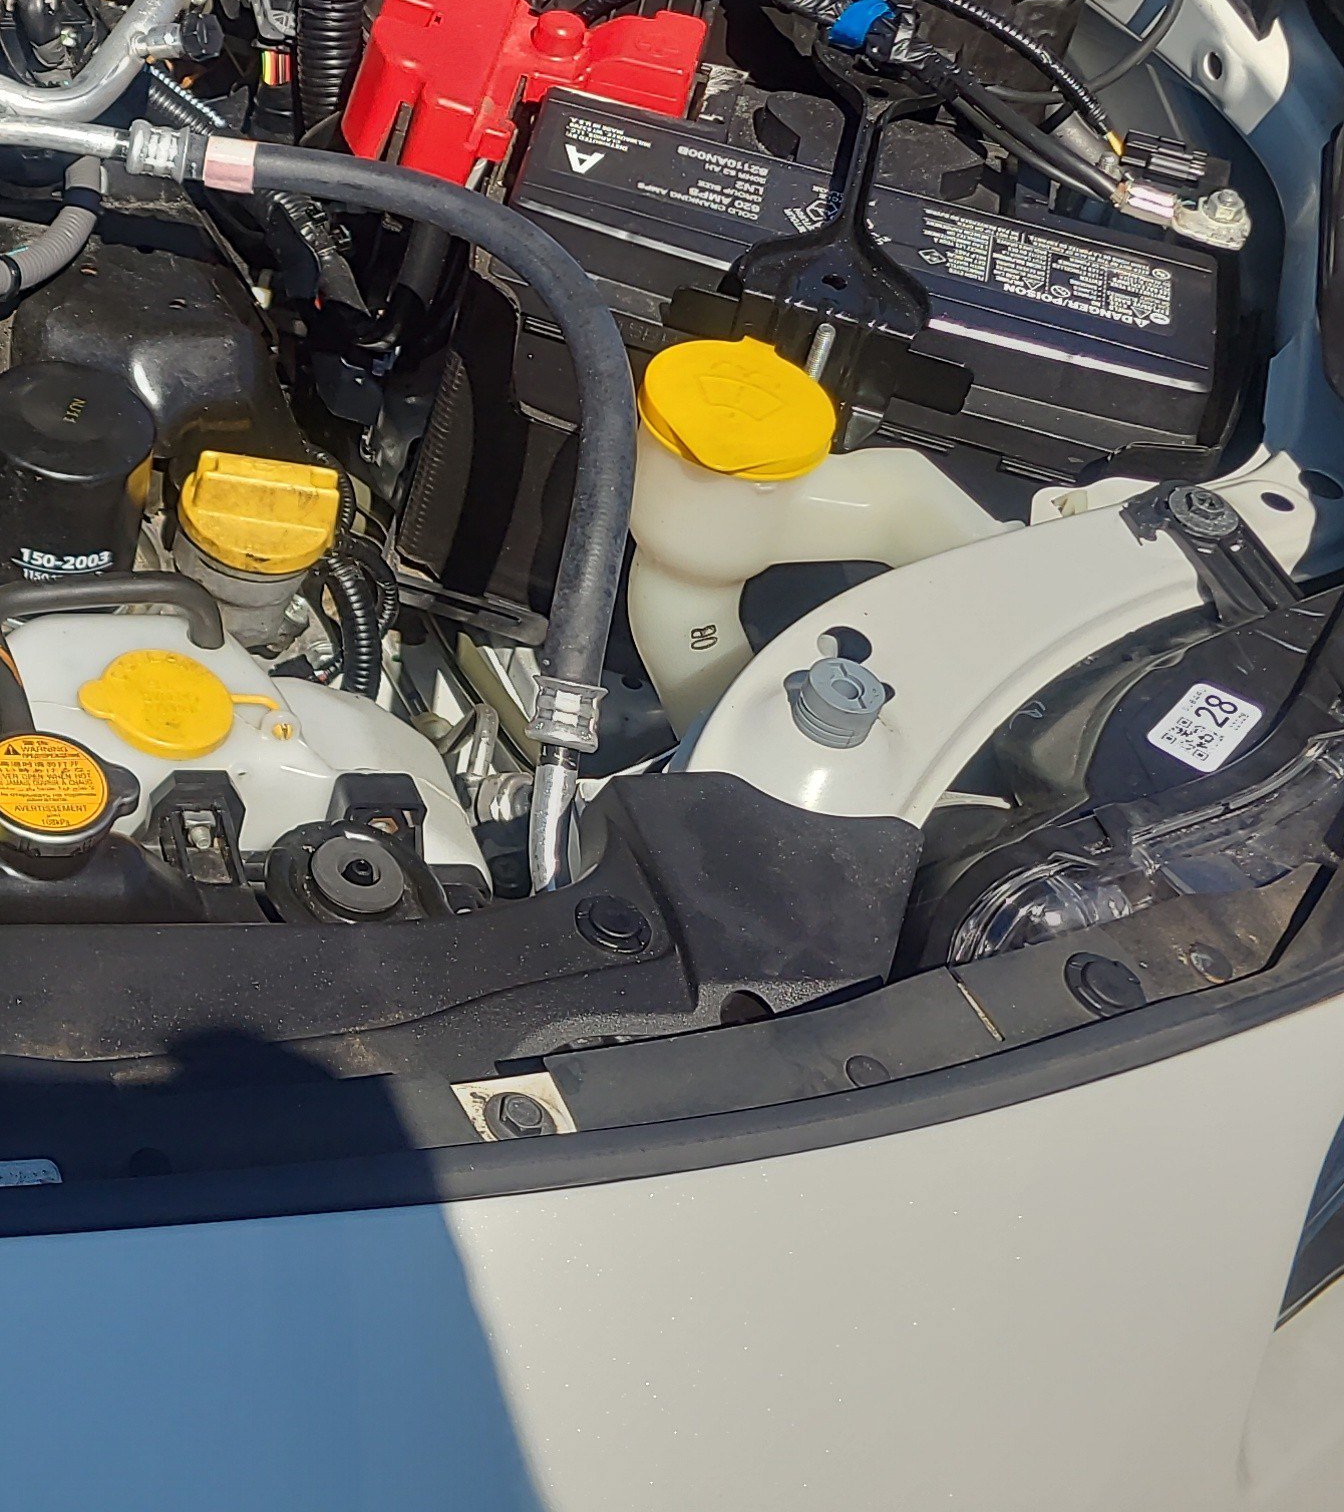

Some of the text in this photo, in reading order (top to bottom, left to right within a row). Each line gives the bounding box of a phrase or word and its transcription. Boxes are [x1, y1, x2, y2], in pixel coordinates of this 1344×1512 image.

[636, 180, 759, 220] COLD CRANKING AMPS
[686, 185, 732, 205] AMPS
[733, 179, 764, 194] LN2
[1002, 281, 1134, 325] DANGER/POISON
[20, 548, 113, 570] 150-2003
[1194, 693, 1236, 728] 28
